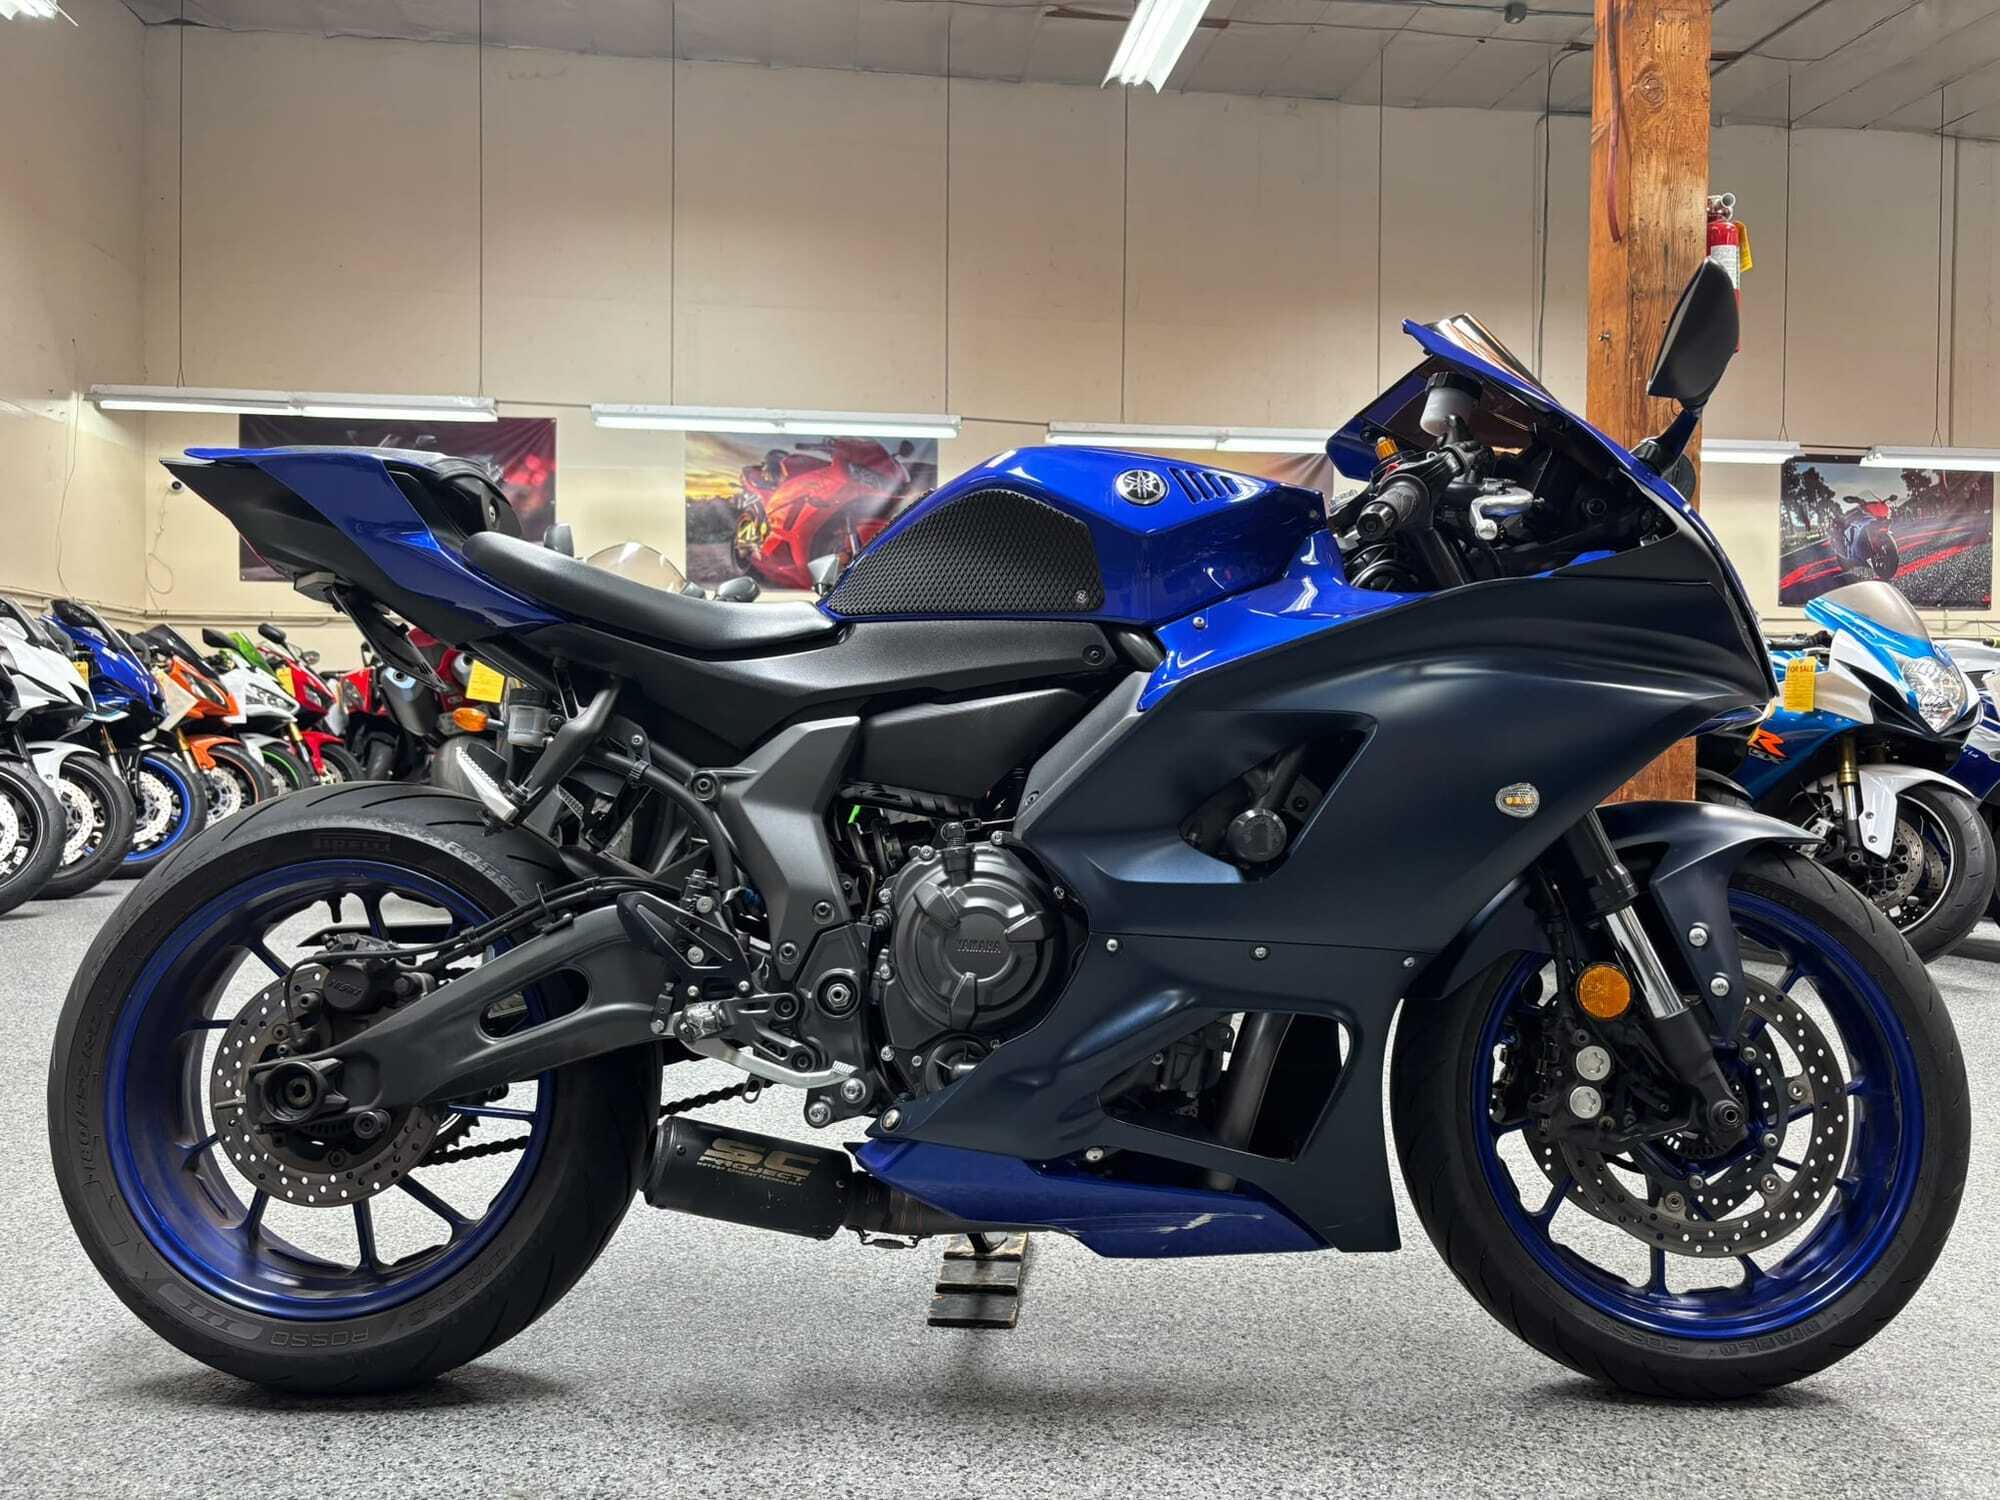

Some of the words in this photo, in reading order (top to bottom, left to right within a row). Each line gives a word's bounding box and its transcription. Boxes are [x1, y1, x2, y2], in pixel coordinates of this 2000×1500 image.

[957, 939, 1001, 953] YAMAHA
[704, 1137, 820, 1177] SC
[698, 1155, 807, 1183] PROJECT
[270, 1328, 369, 1347] ROSSO
